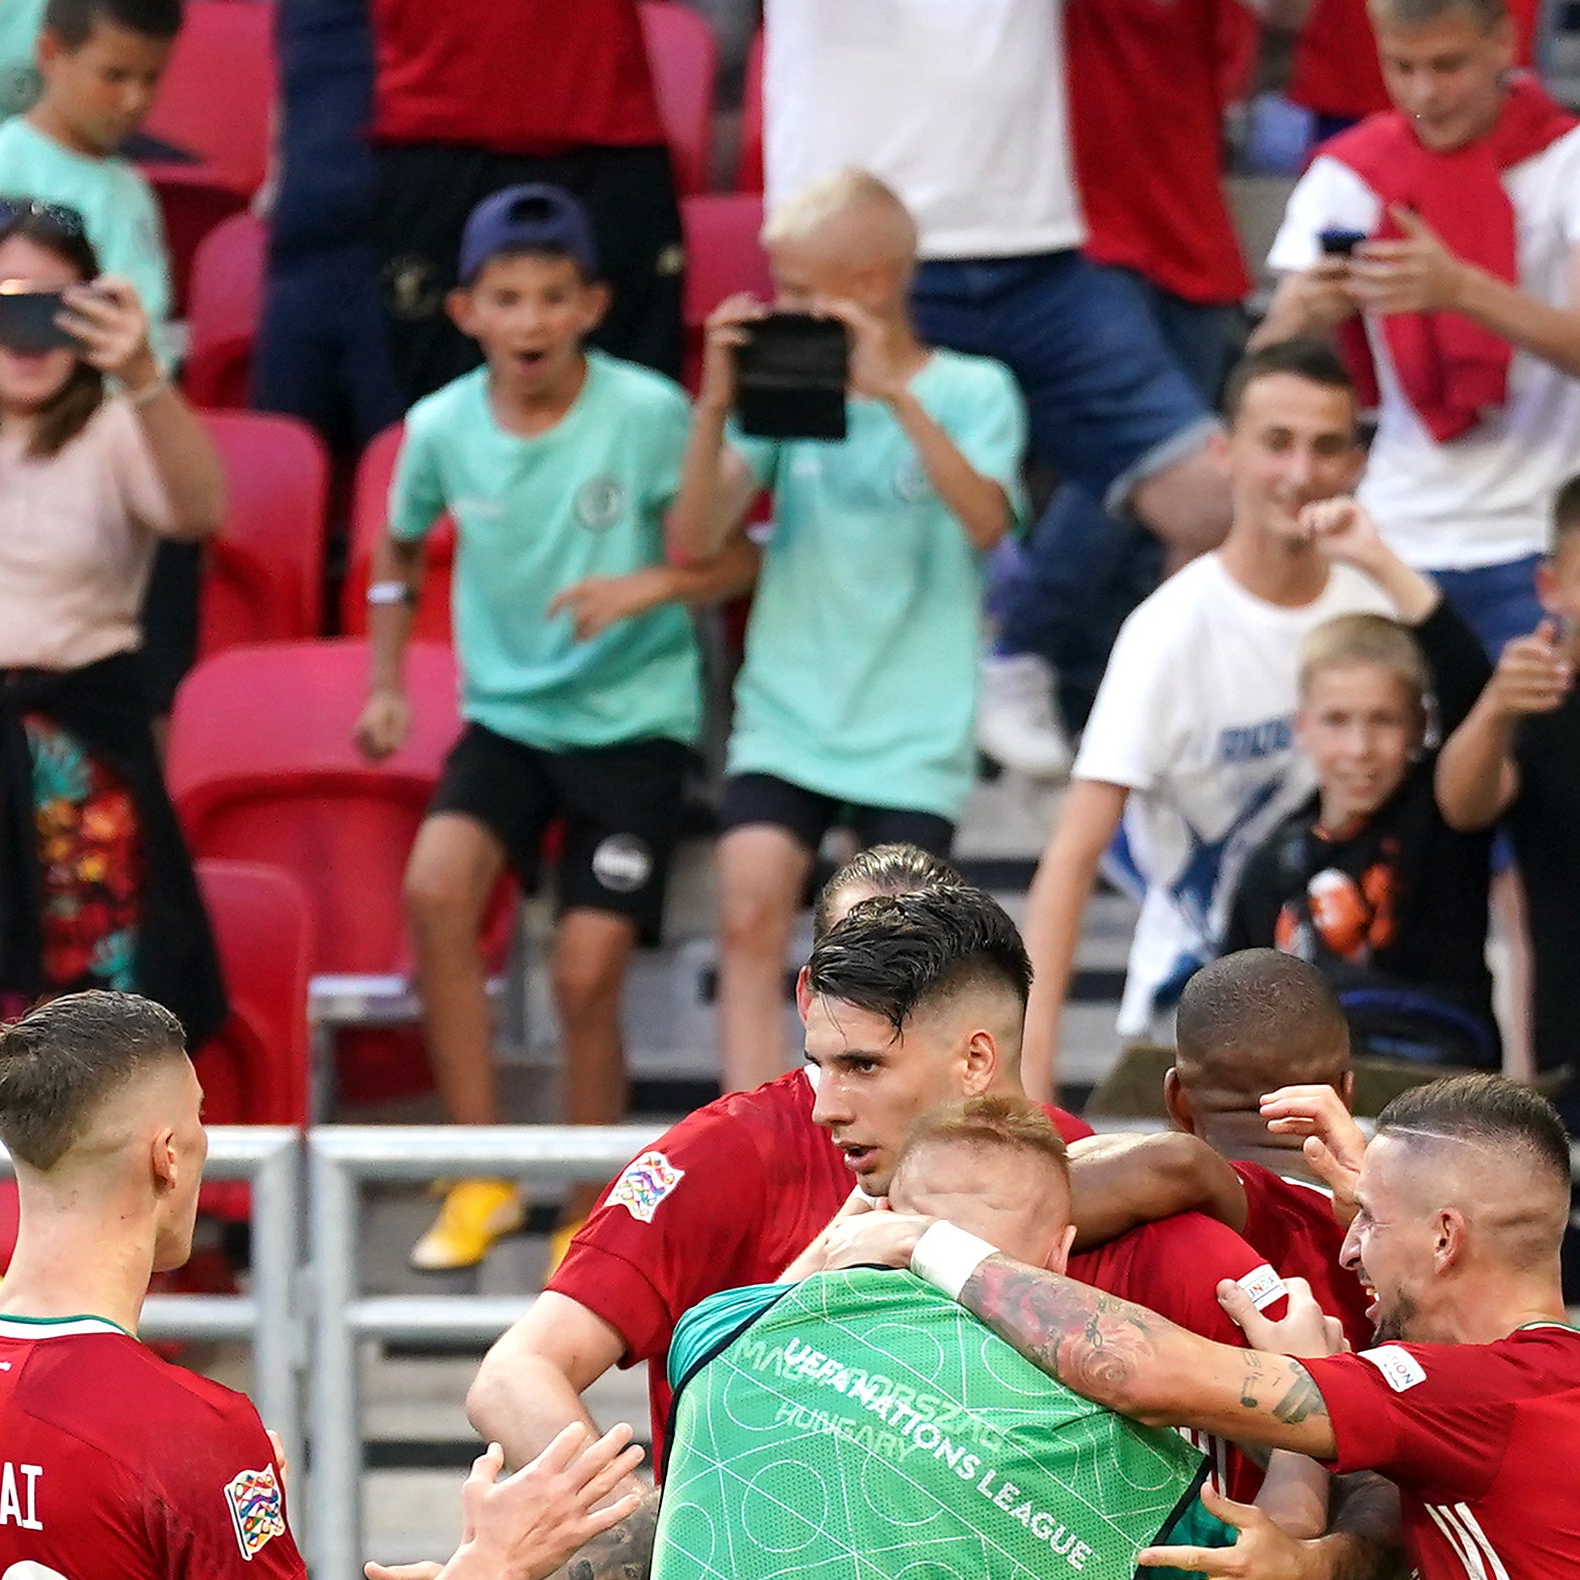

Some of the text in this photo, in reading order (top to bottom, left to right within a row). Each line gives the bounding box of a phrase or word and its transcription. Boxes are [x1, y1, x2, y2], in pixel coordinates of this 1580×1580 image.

[784, 1336, 1094, 1571] UEFA NATIONS LEAGUE
